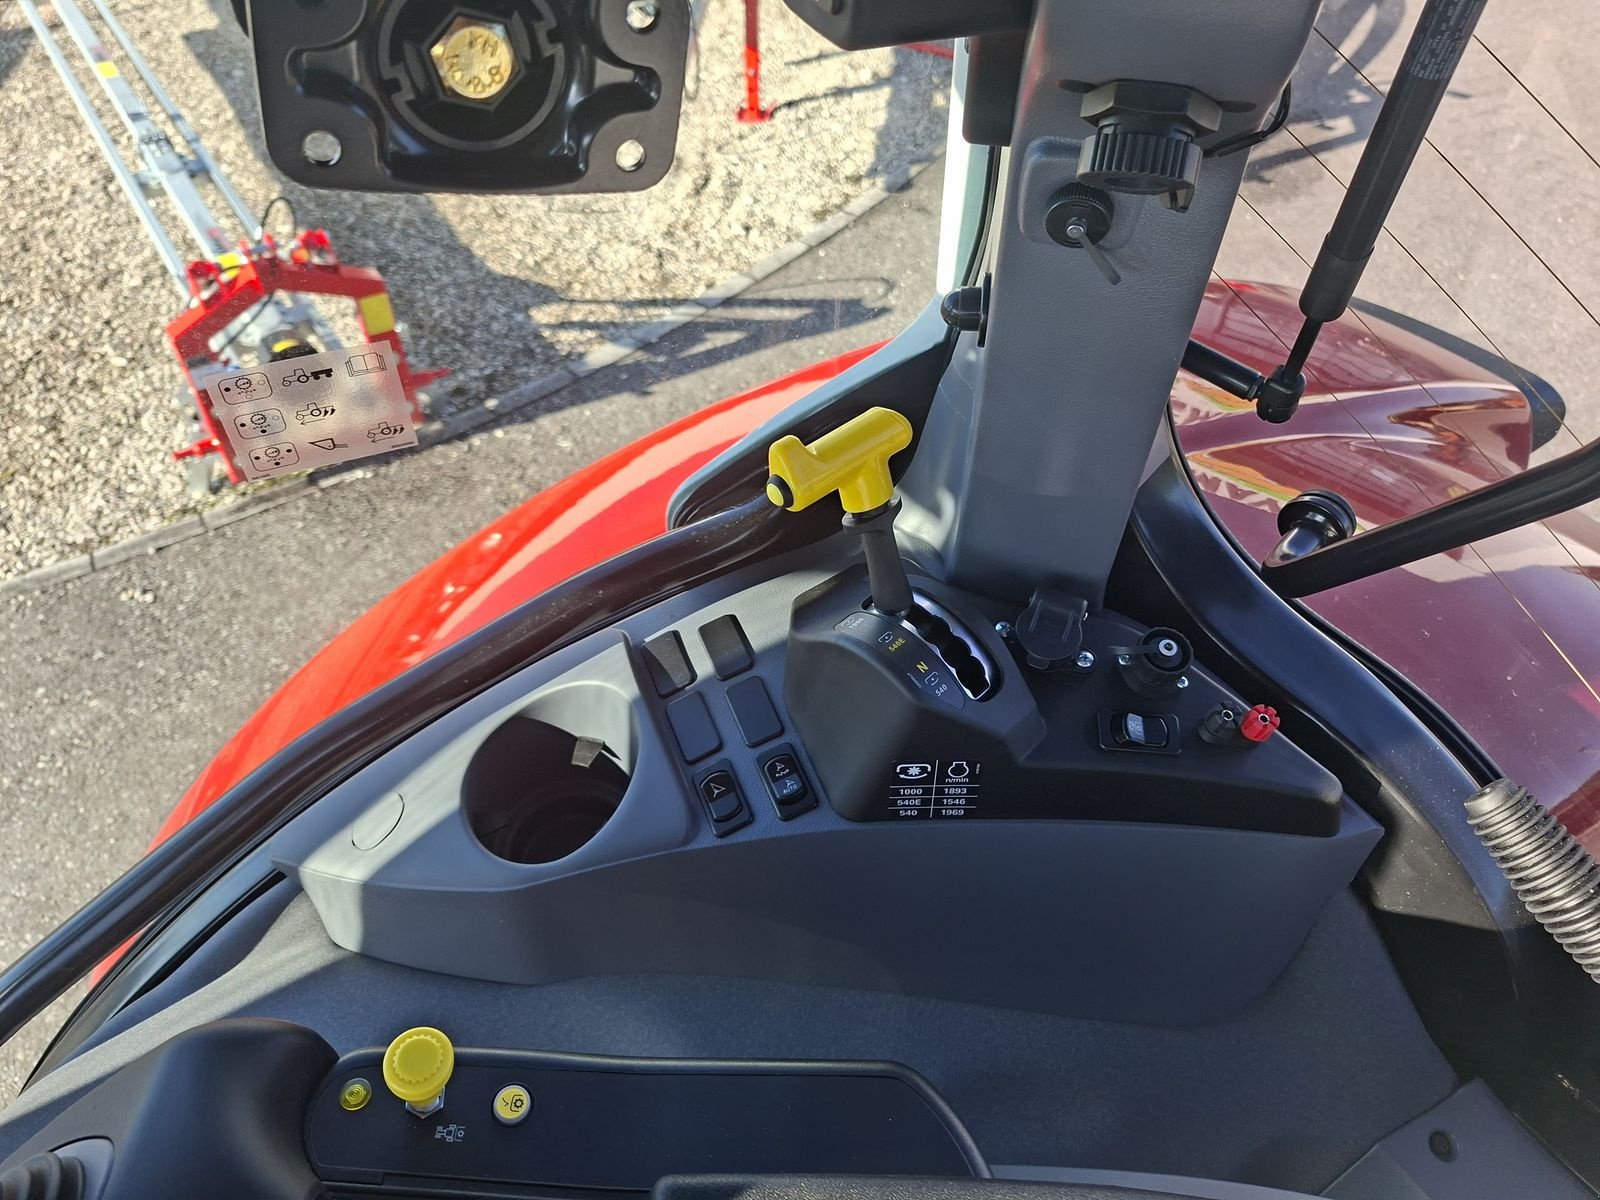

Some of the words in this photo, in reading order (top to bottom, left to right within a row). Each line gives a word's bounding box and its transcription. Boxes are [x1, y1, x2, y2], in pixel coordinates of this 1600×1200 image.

[888, 637, 906, 652] 540E
[916, 661, 929, 674] N
[935, 684, 948, 697] 540
[783, 784, 798, 793] AUTO
